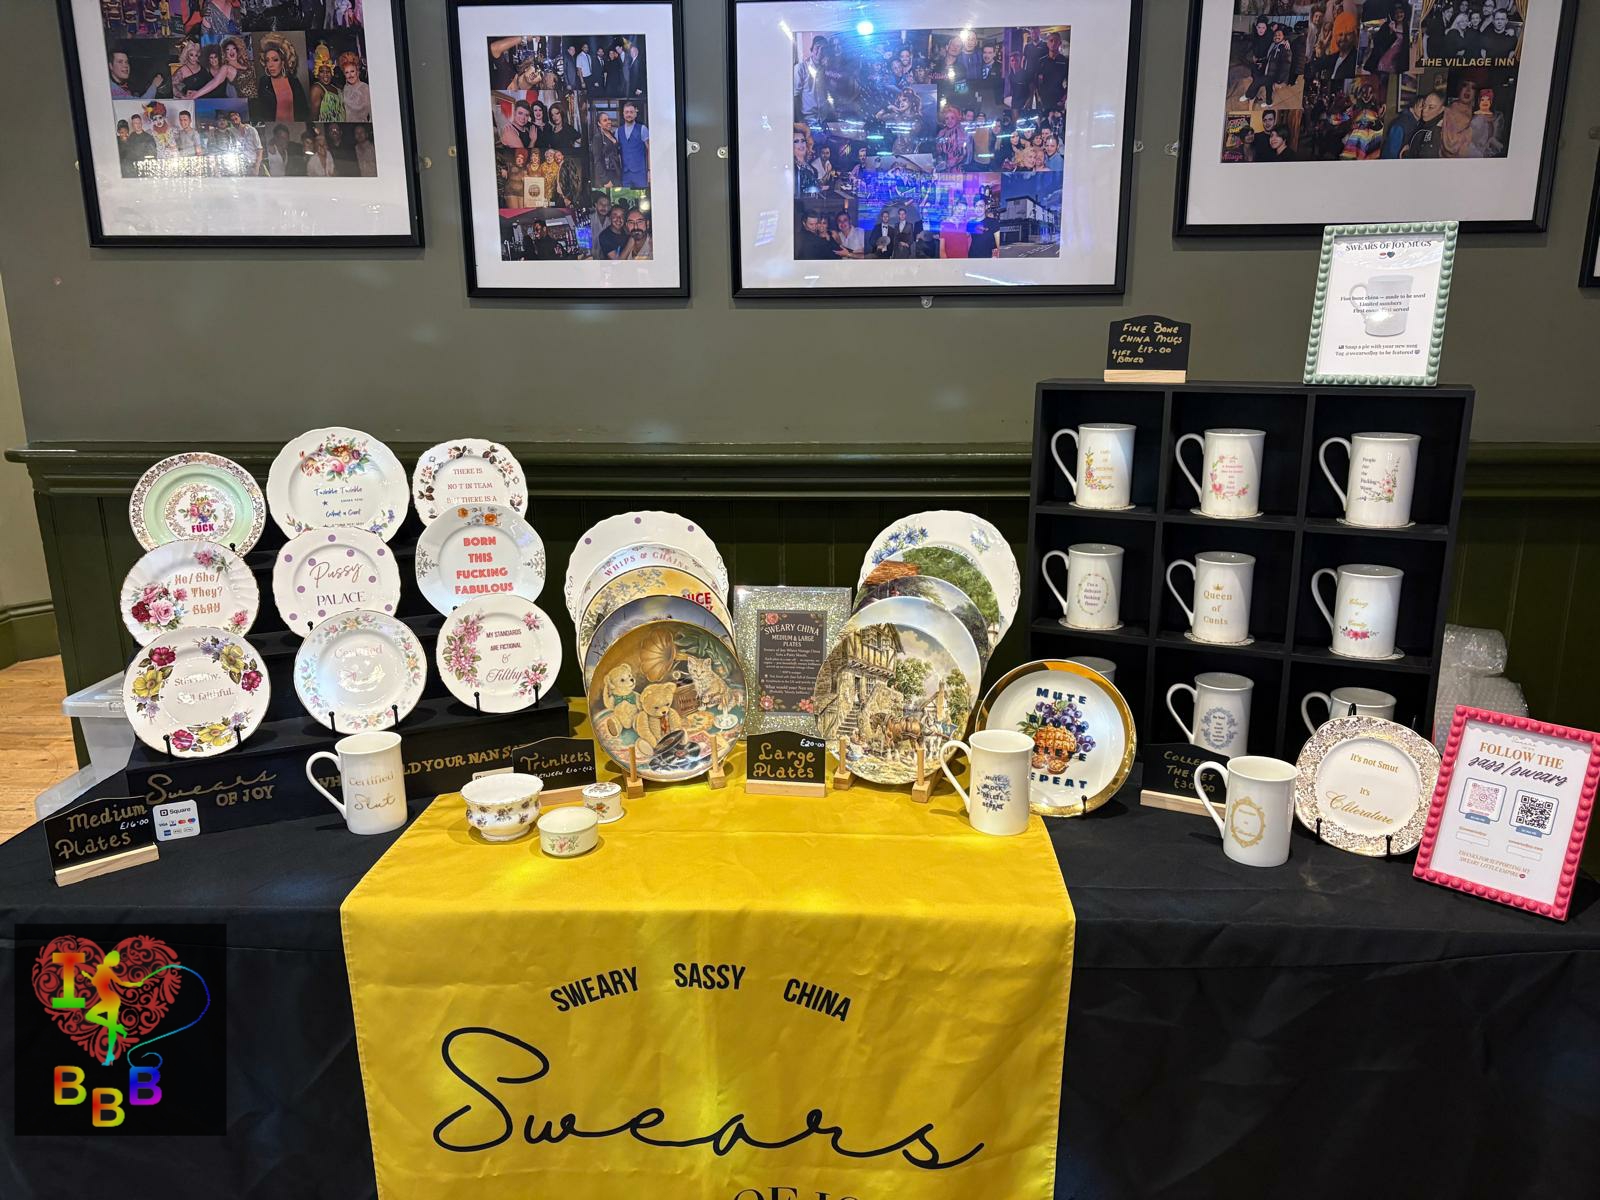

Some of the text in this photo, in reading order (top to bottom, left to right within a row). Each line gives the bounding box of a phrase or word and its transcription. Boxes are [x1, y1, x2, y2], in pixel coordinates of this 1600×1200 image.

[1421, 58, 1515, 66] THE VILLAGE INN
[1345, 243, 1378, 251] SWEARS
[1392, 241, 1407, 249] JOY
[1407, 240, 1432, 248] MUGS
[1122, 321, 1179, 334] FINE BONE
[1119, 334, 1183, 345] CHINA MUGS
[191, 523, 216, 533] FUCK
[463, 536, 497, 547] BORN
[467, 552, 493, 563] THIS
[604, 554, 637, 577] WHIPS
[652, 550, 690, 571] CHAINS
[309, 561, 364, 589] Pussy
[456, 567, 508, 579] FUCKING
[191, 586, 223, 598] They?
[455, 582, 514, 595] FABULOUS
[1203, 591, 1233, 601] Queen
[316, 591, 367, 606] PALACE
[1203, 615, 1229, 625] Cunts
[494, 629, 522, 638] STANDARDS
[764, 624, 820, 636] SWEARY CHINA
[500, 642, 522, 651] FICTIONAL
[486, 667, 522, 685] Filthy
[1036, 687, 1088, 705] MUTE
[421, 755, 466, 773] YOUR
[466, 748, 500, 764] NAN
[758, 742, 816, 768] Large
[1032, 744, 1087, 762] ELETE
[1163, 750, 1205, 766] COLLE
[1479, 741, 1565, 769] FOLLOW THE
[520, 752, 592, 771] Trinkets
[1363, 757, 1378, 768] not
[1377, 760, 1400, 774] Smut
[752, 762, 815, 779] Plates
[1166, 765, 1190, 777] THE
[349, 771, 394, 786] Certified
[1030, 772, 1088, 789] EPEAT
[146, 770, 277, 805] Swears
[216, 785, 275, 808] OF JOY
[67, 803, 149, 833] Medium
[170, 807, 191, 815] Square
[55, 831, 133, 860] Plates
[550, 962, 852, 1022] SWEARY SASSY CHINA
[432, 1026, 986, 1171] Swears
